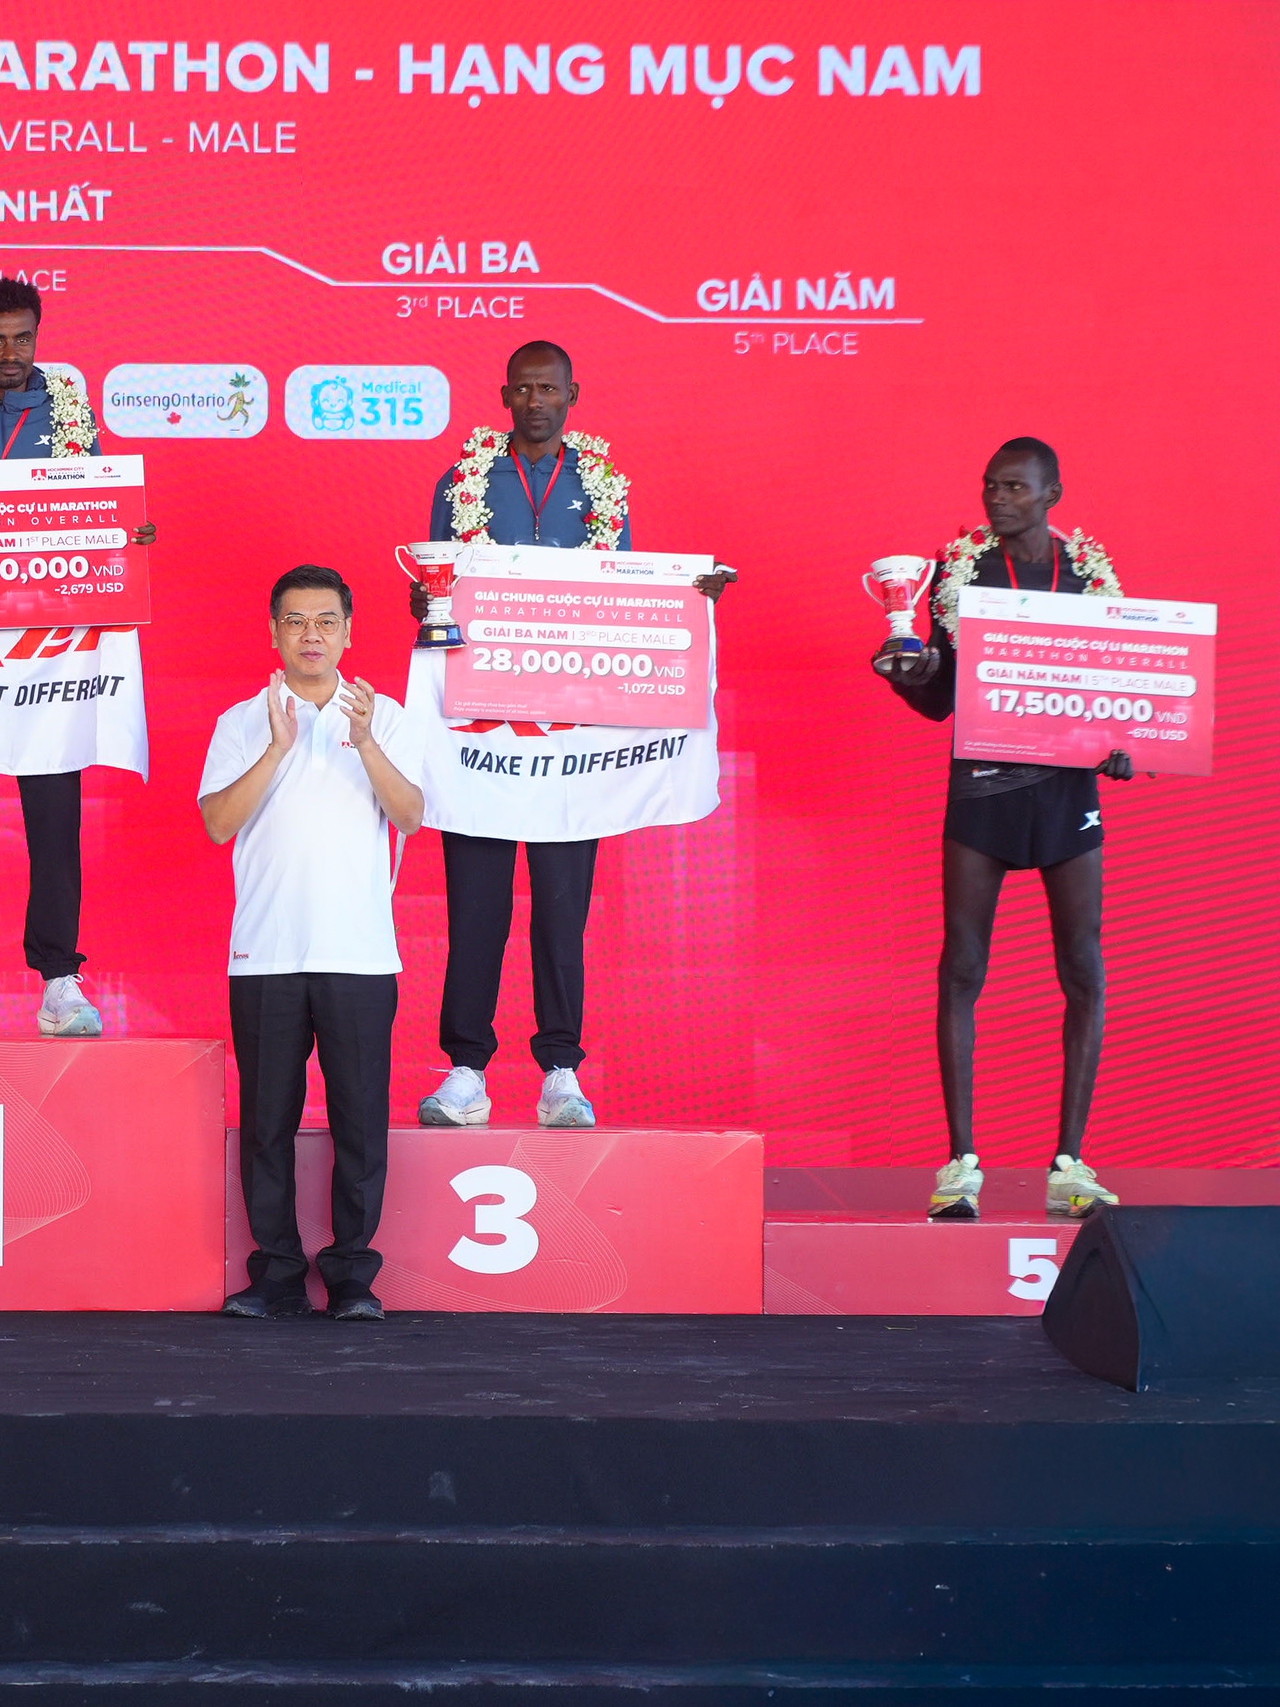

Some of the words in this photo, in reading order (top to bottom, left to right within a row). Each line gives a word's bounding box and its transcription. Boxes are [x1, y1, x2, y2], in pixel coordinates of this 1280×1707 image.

[398, 42, 606, 109] HẠNG
[629, 43, 795, 110] MỤC
[818, 44, 982, 97] NAM
[188, 120, 297, 154] MALE
[381, 235, 467, 276] GIẢI
[480, 240, 541, 274] BA
[696, 272, 783, 313] GIẢI
[795, 271, 896, 311] NĂM
[396, 294, 429, 318] 3rd
[437, 295, 525, 319] PLACE
[734, 331, 766, 355] 5th
[773, 332, 859, 356] PLACE
[361, 381, 420, 393] Medical
[111, 393, 225, 411] GinsengOntario
[360, 397, 424, 427] 315
[17, 502, 36, 515] CỰ
[37, 503, 47, 513] LI
[49, 500, 118, 512] MARATHON
[31, 514, 118, 526] OVERALL
[25, 536, 39, 547] 1ST
[41, 535, 81, 547] PLACE
[85, 533, 119, 545] MALE
[93, 564, 125, 577] VND
[96, 582, 125, 593] USD
[474, 590, 499, 601] GIẢI
[501, 592, 544, 603] CHUNG
[546, 593, 581, 607] CUỘC
[603, 596, 614, 606] LI
[616, 597, 684, 609] MARATHON
[475, 605, 580, 618] MARATHON
[596, 610, 683, 623] OVERALL
[514, 628, 533, 638] BA
[537, 629, 568, 640] NAM
[598, 631, 638, 644] PLACE
[642, 634, 677, 645] MALE
[1009, 634, 1053, 647] CHUNG
[1121, 642, 1190, 656] MARATHON
[472, 646, 653, 679] 28,000,000
[654, 665, 686, 679] VND
[983, 646, 1089, 662] MARATHON
[1102, 655, 1188, 670] OVERALL
[14, 675, 125, 707] DIFFERENT
[657, 684, 686, 696] USD
[1051, 673, 1081, 684] NAM
[1111, 676, 1150, 690] PLACE
[1153, 680, 1187, 692] MALE
[984, 688, 1153, 722] 17,500,000
[1155, 711, 1188, 724] VND
[1160, 729, 1189, 741] USD
[460, 746, 523, 776] MAKE
[530, 755, 554, 777] IT
[561, 734, 688, 776] DIFFERENT
[447, 1165, 539, 1275] 3
[1007, 1238, 1060, 1302] 5
